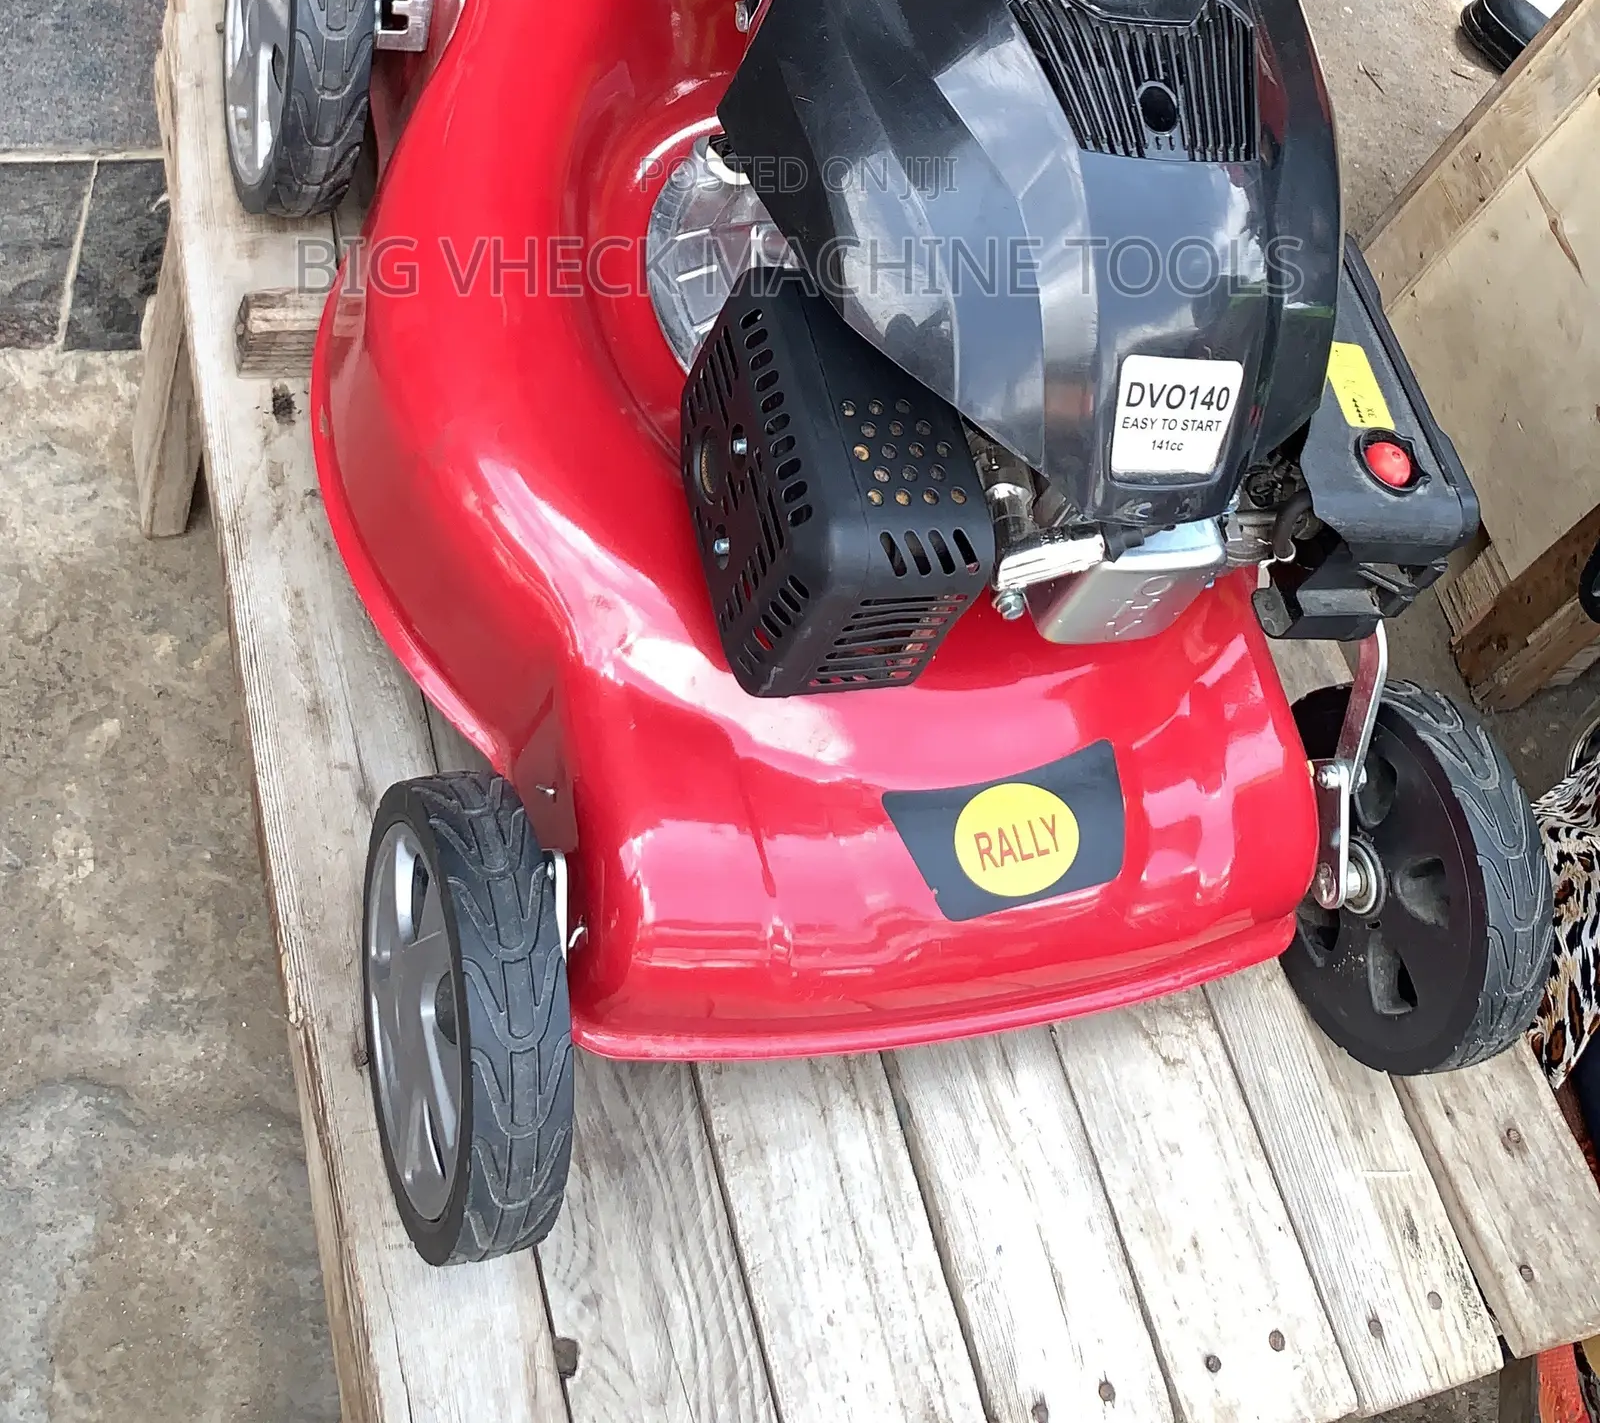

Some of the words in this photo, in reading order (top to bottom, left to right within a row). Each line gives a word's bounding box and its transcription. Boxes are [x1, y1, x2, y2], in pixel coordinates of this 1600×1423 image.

[1122, 416, 1158, 430] EASY
[1162, 418, 1178, 431] TO
[1181, 419, 1222, 432] START
[1151, 440, 1184, 451] 141cc
[974, 814, 1060, 872] RALLY
